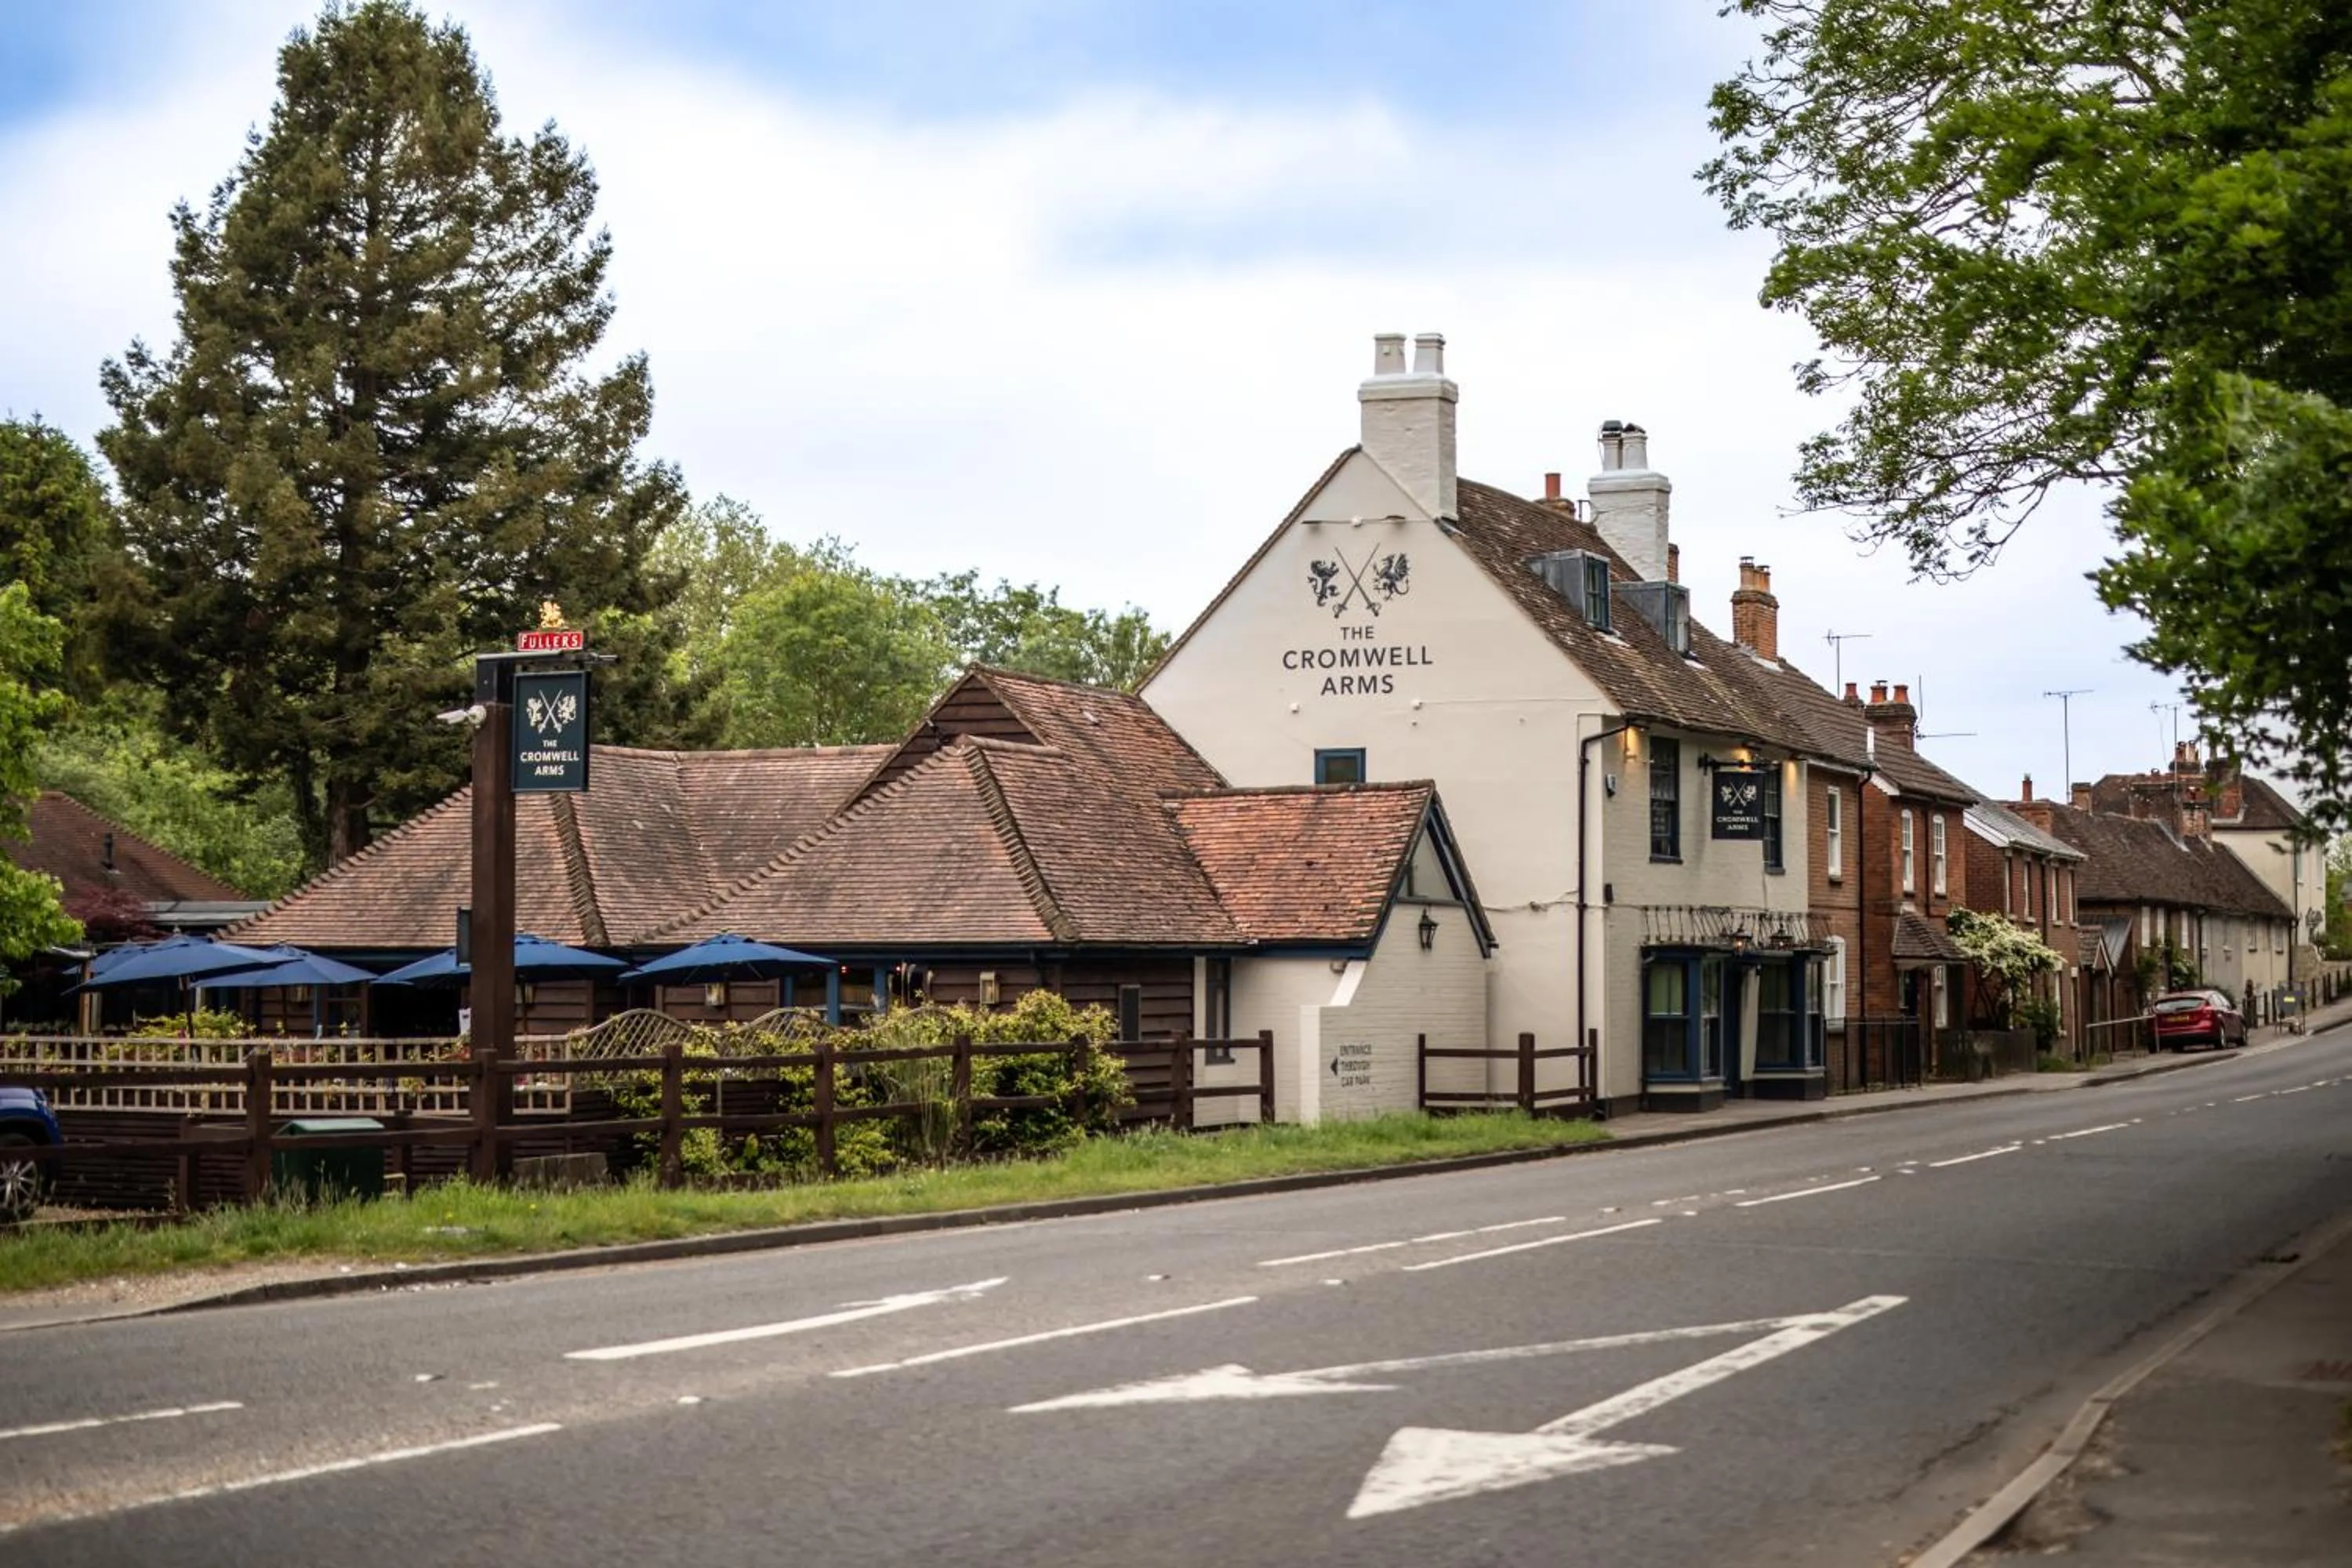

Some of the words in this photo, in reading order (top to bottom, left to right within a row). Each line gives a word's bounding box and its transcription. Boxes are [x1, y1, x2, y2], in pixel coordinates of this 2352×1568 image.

[1340, 626, 1374, 640] THE
[1282, 645, 1433, 670] CROMWELL
[1320, 674, 1394, 696] ARMS
[520, 750, 579, 762] CROMWELL
[535, 764, 564, 775] ARMS
